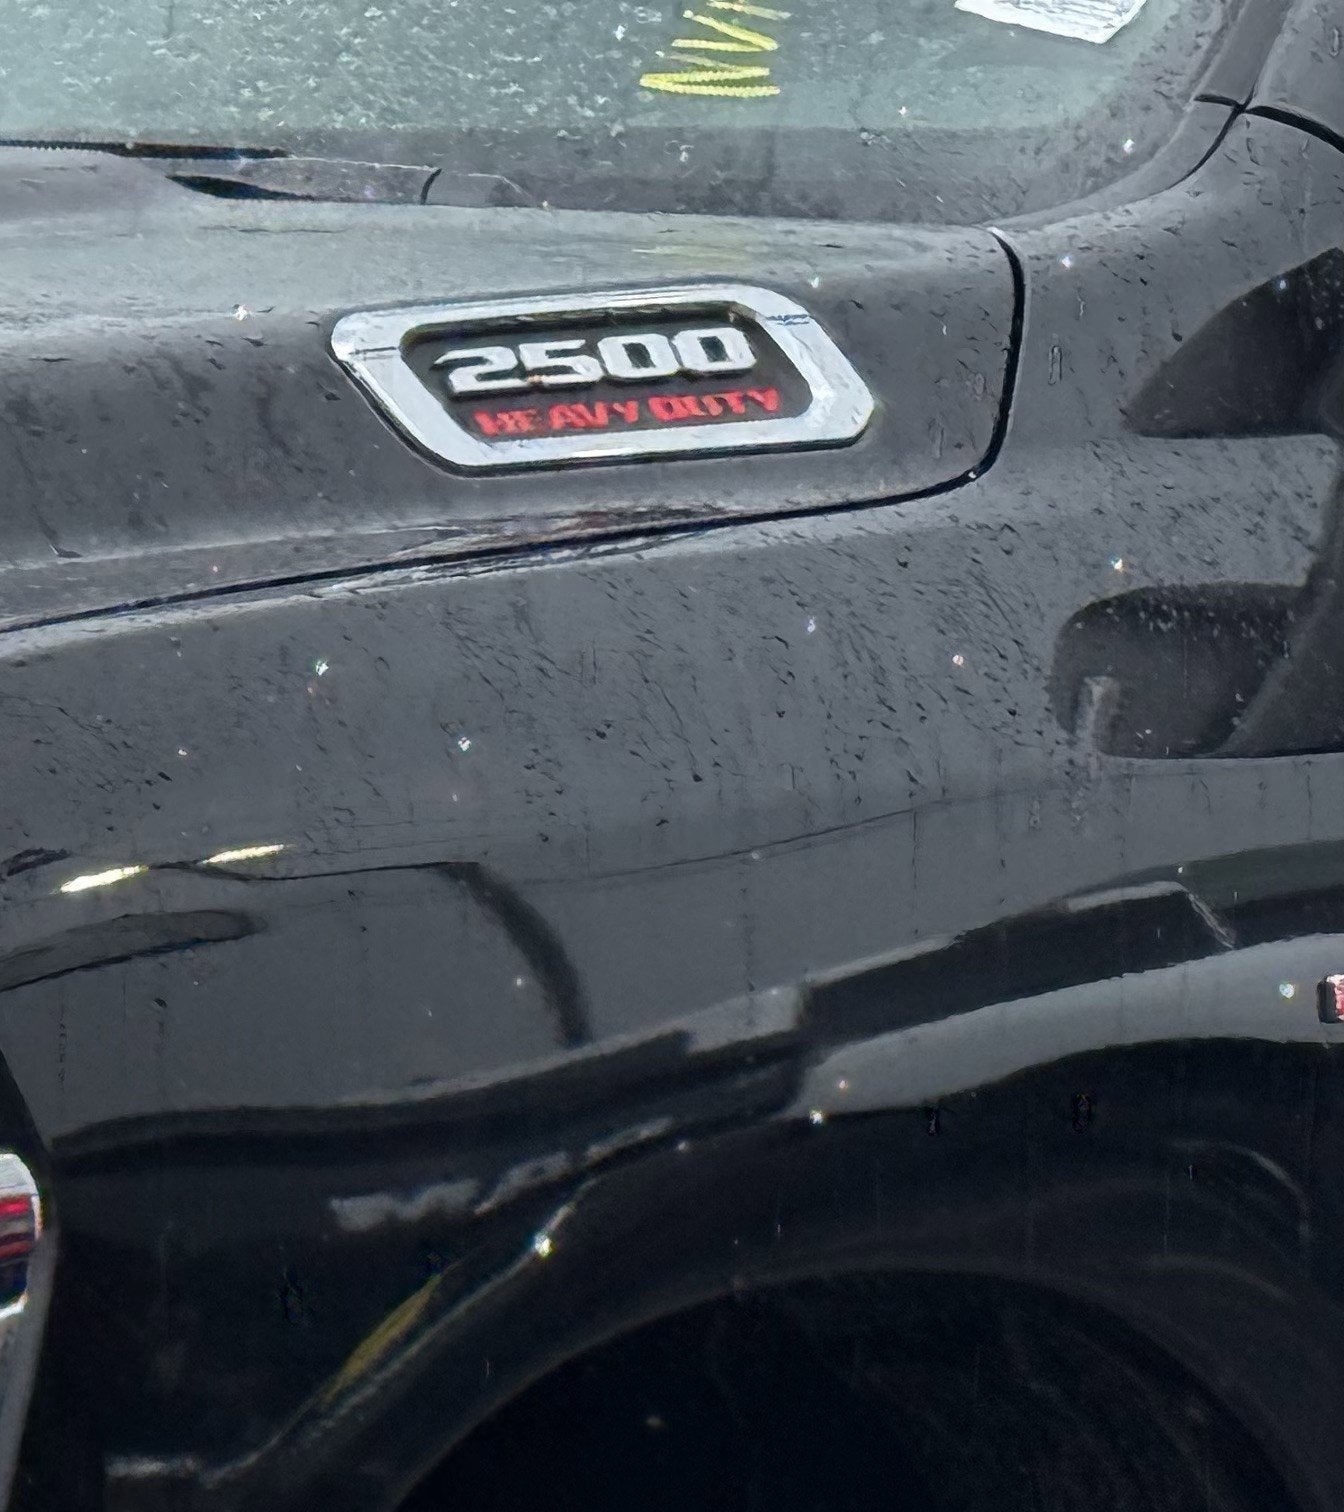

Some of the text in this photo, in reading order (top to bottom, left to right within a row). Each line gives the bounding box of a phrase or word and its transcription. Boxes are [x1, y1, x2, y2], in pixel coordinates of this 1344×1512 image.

[433, 327, 758, 396] 2500
[471, 386, 781, 439] HEAVY DUTY
